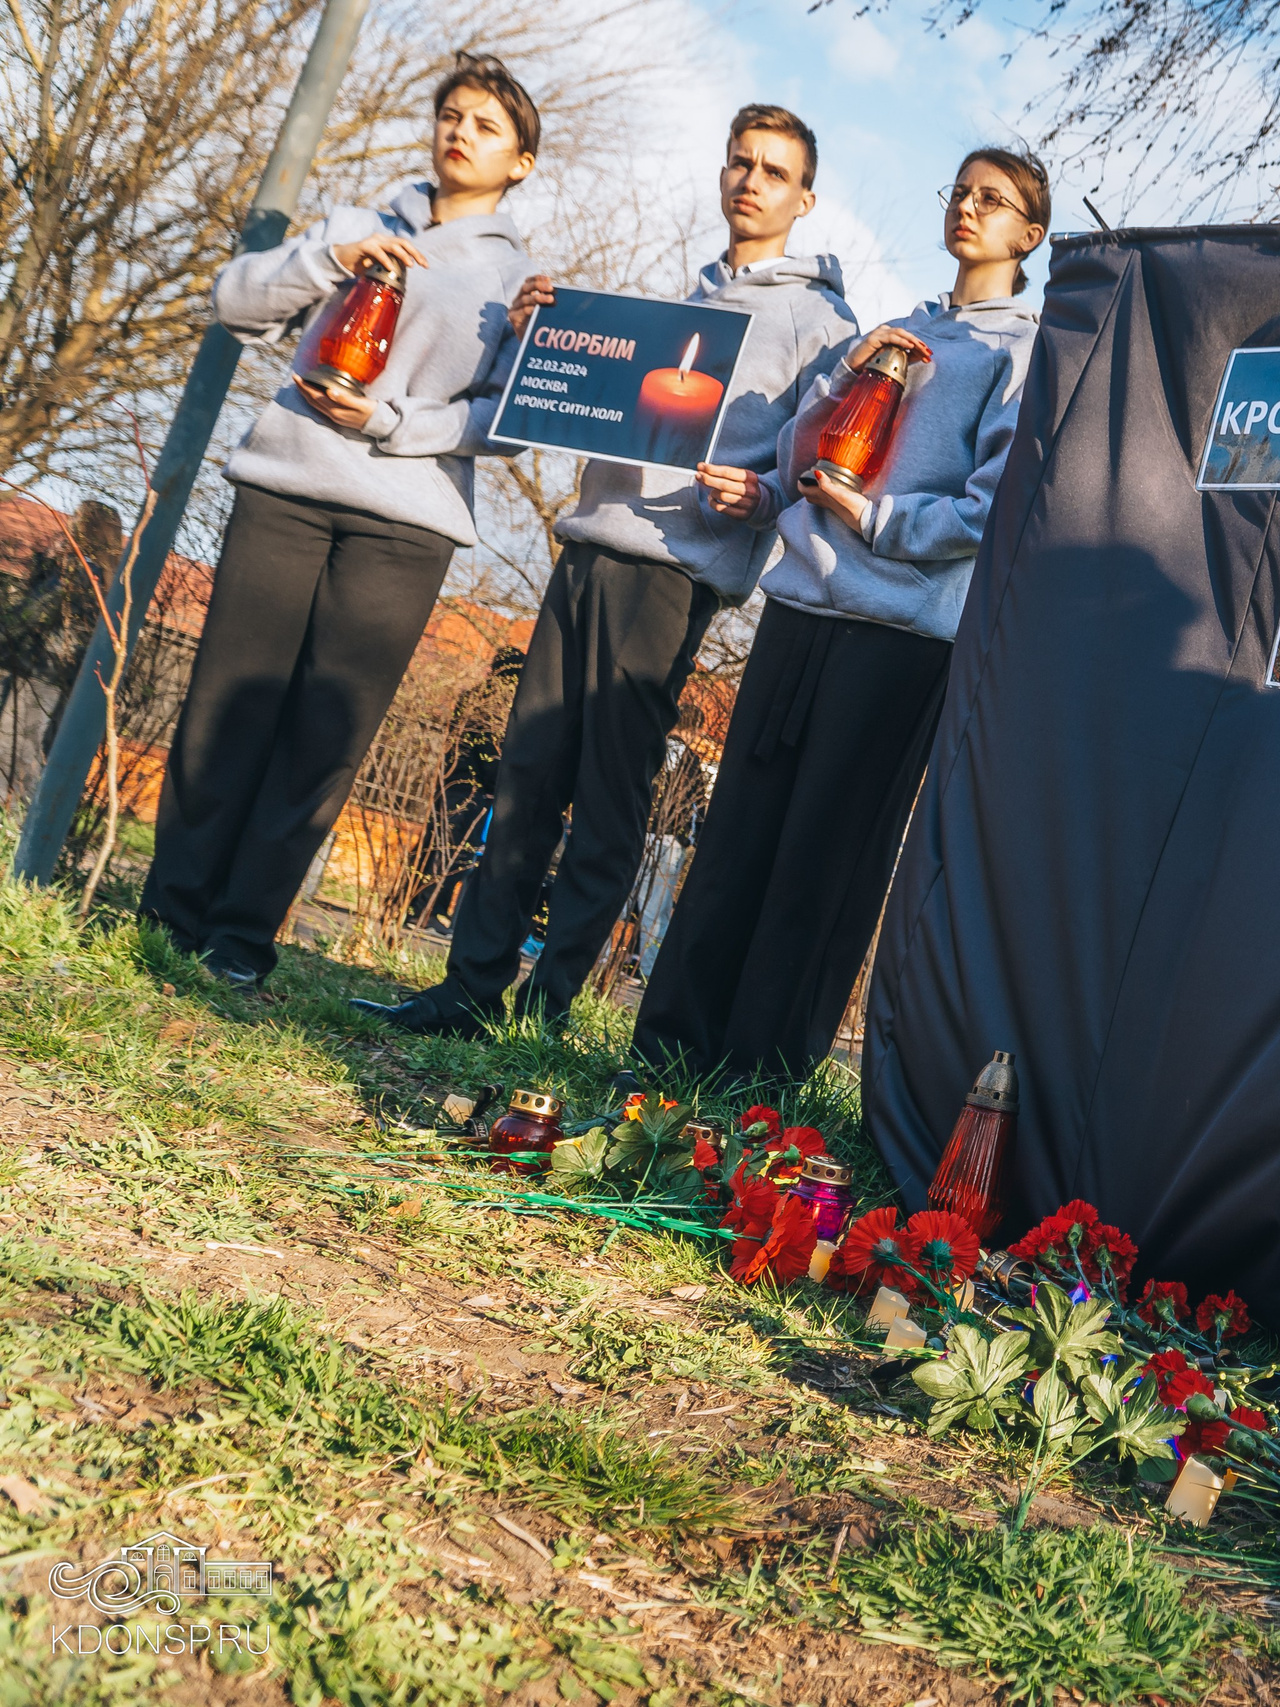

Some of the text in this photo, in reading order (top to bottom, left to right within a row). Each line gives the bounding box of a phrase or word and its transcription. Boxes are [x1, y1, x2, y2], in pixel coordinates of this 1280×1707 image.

[534, 326, 637, 361] СКОРБИМ
[527, 356, 588, 377] 22.03.2024
[520, 375, 568, 393] МОСКВА
[513, 393, 624, 422] КРОКУС СИТИ ХОЛЛ
